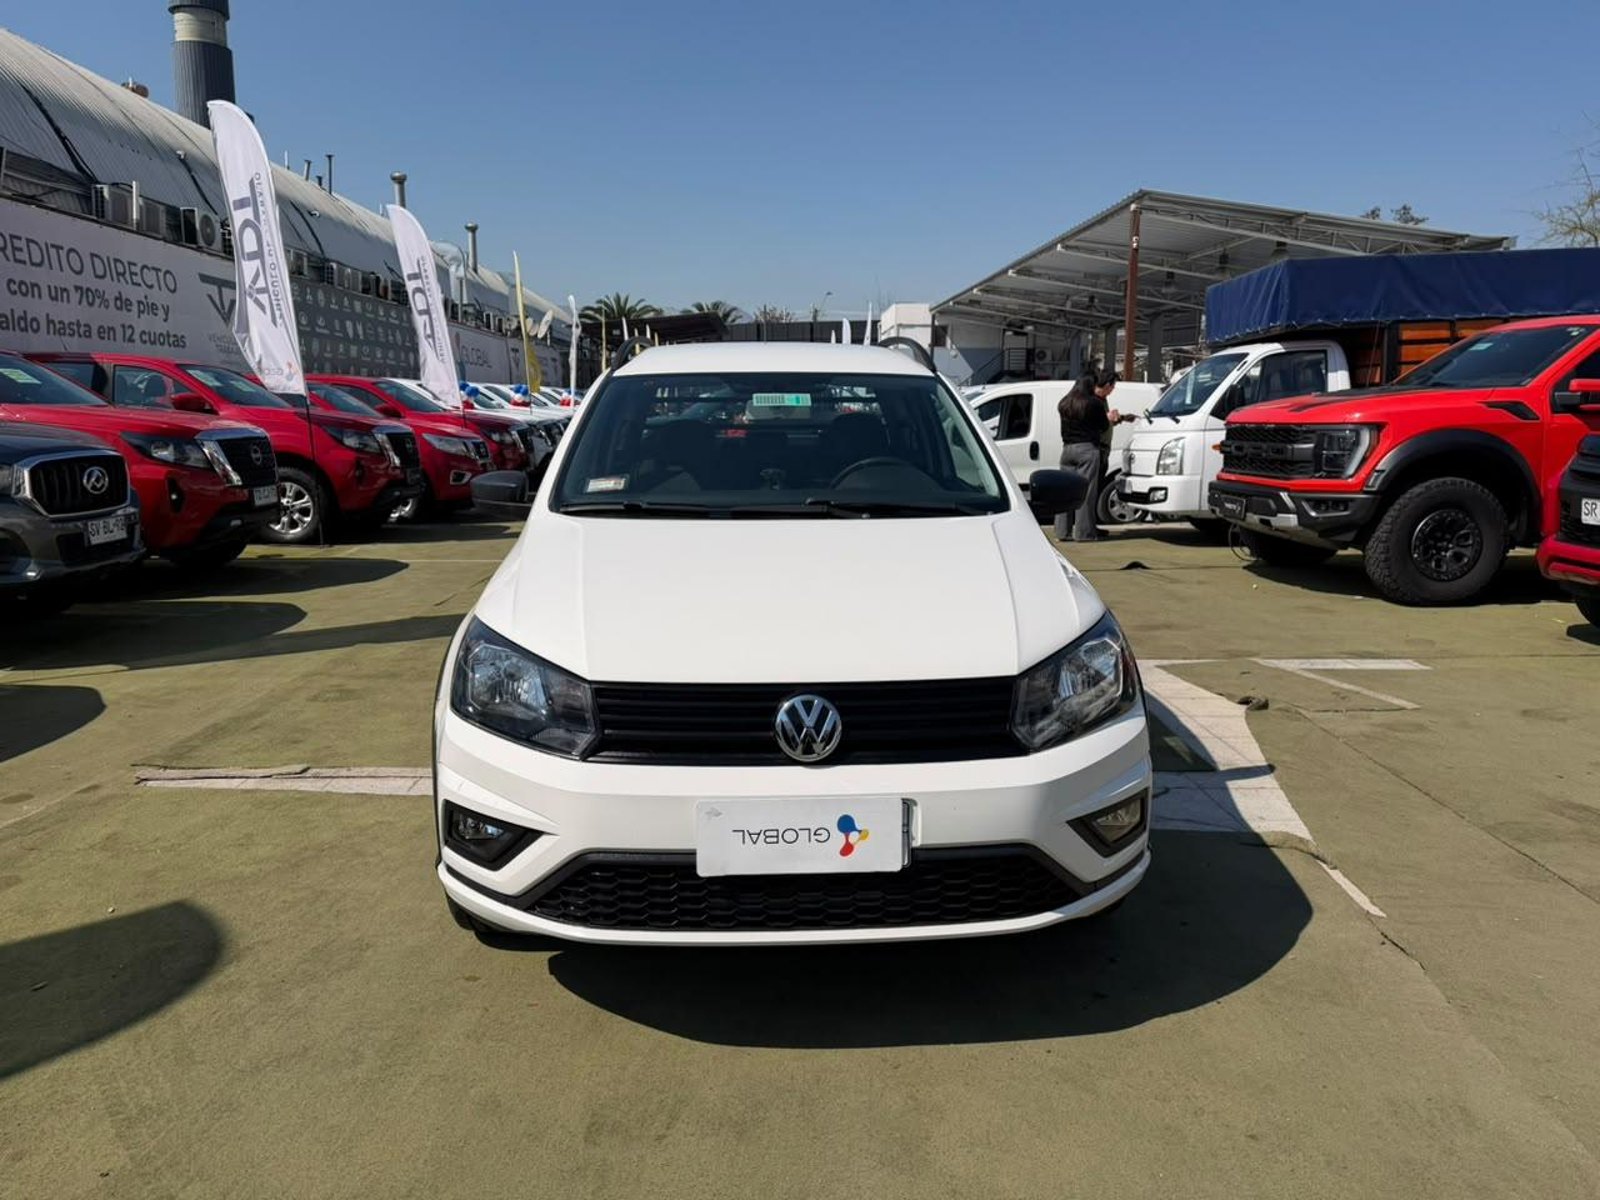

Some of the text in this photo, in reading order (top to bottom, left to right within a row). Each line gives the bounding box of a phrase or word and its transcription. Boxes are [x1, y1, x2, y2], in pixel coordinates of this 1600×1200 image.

[89, 252, 177, 294] DIRECTO
[6, 278, 170, 322] con un 70% de pie y
[46, 313, 92, 339] hasta
[97, 325, 117, 342] en
[121, 323, 135, 343] 12
[139, 329, 187, 349] cuotas
[732, 826, 831, 845] GLOBAL
